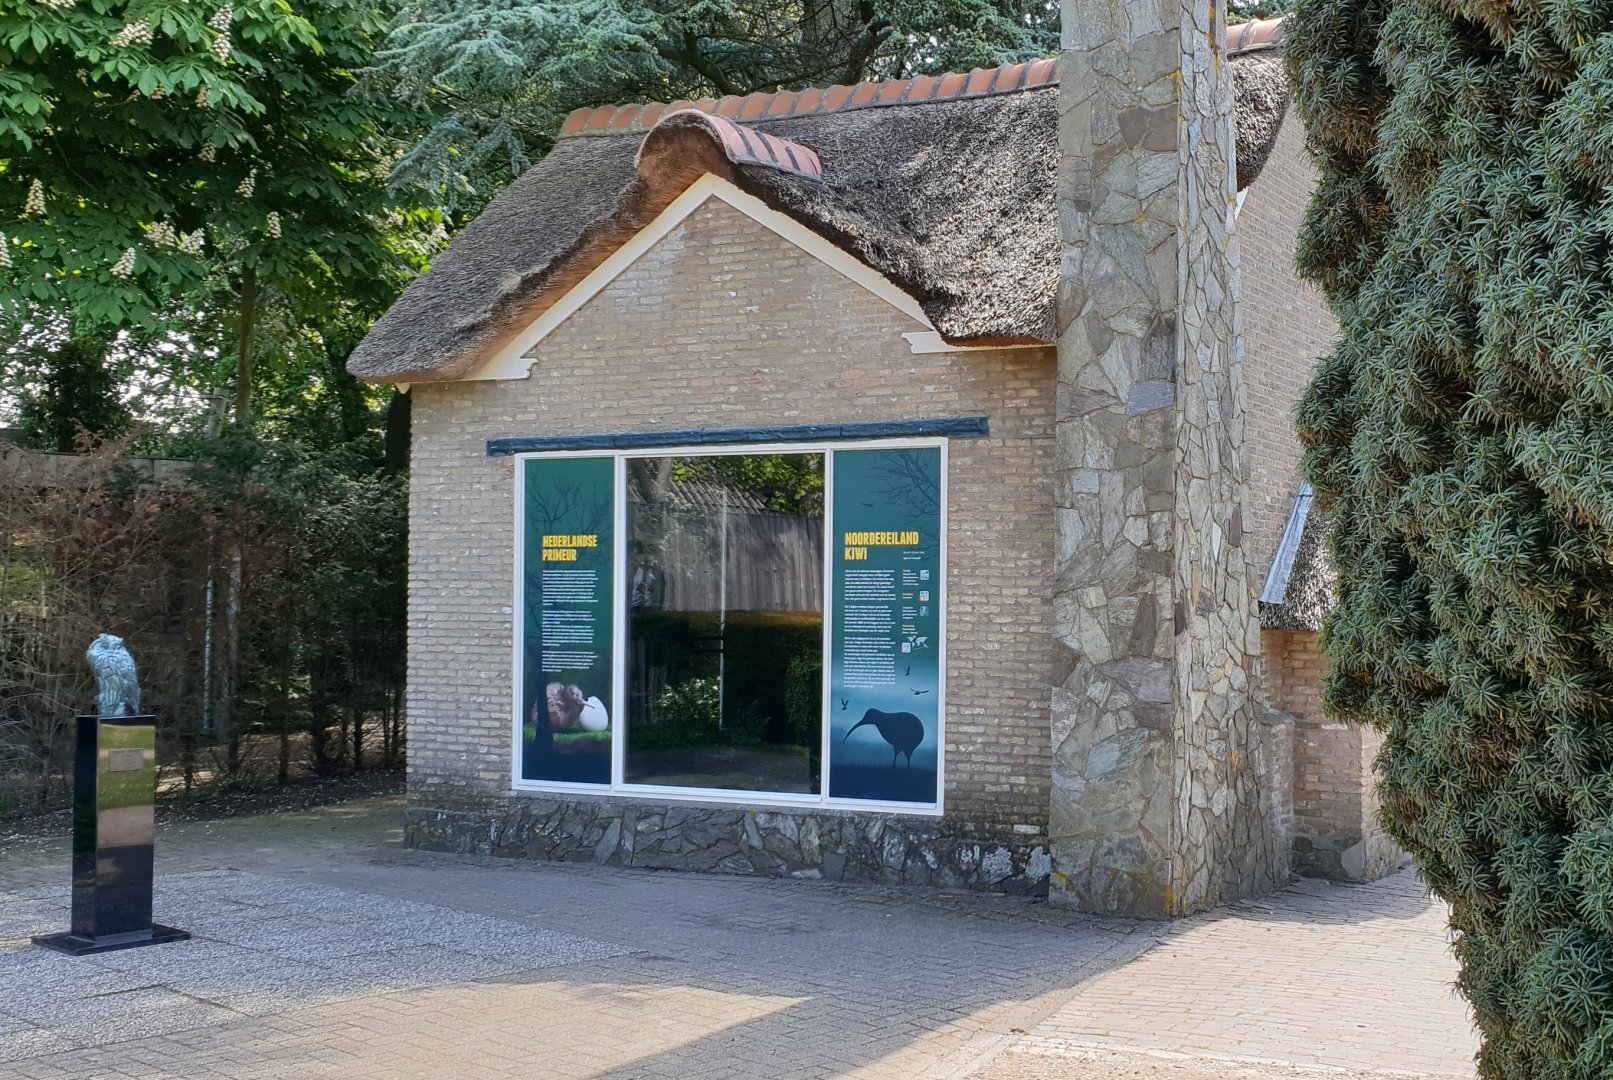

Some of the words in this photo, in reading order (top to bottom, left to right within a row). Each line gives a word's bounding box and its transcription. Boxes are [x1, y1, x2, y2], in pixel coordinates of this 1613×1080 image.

[542, 535, 598, 548] NEDERLANDSE
[845, 532, 919, 546] NOORDEREILAND
[542, 549, 577, 561] PRIMEUR
[845, 547, 867, 560] KIWI
